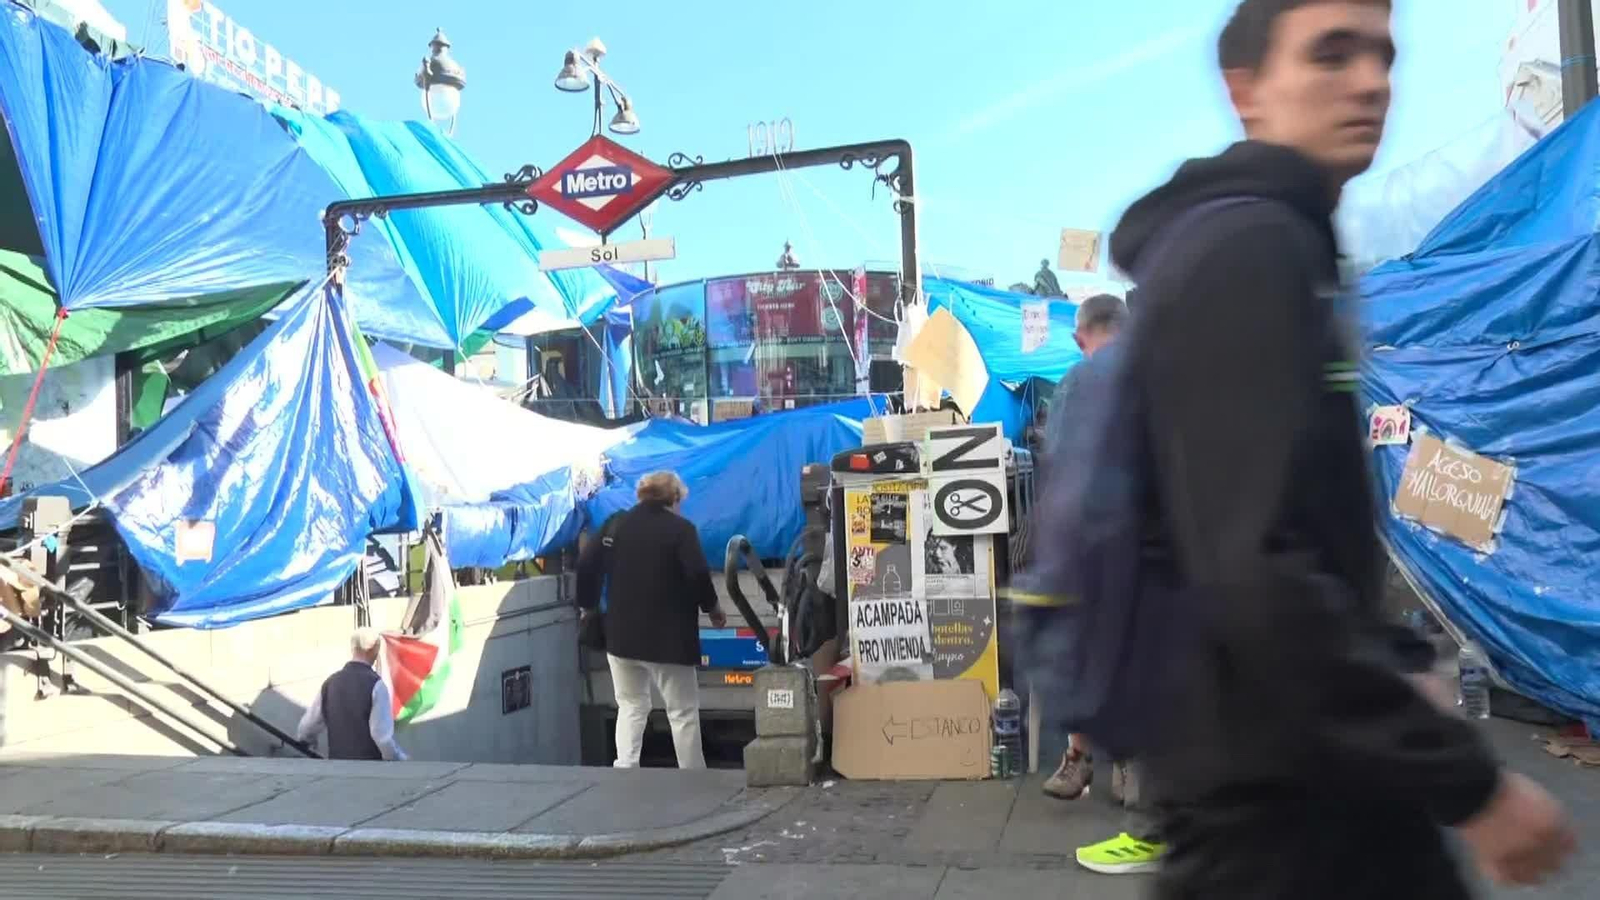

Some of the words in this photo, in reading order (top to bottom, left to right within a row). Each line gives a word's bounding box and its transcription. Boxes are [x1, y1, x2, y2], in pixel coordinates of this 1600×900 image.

[203, 1, 257, 66] TIO
[566, 172, 627, 194] Metro
[591, 247, 618, 262] Sol
[1427, 448, 1482, 484] ACCESO
[857, 600, 923, 628] ACAMPADA
[858, 639, 880, 664] PRO
[880, 635, 926, 663] VIVIENDA
[724, 673, 752, 684] Metro
